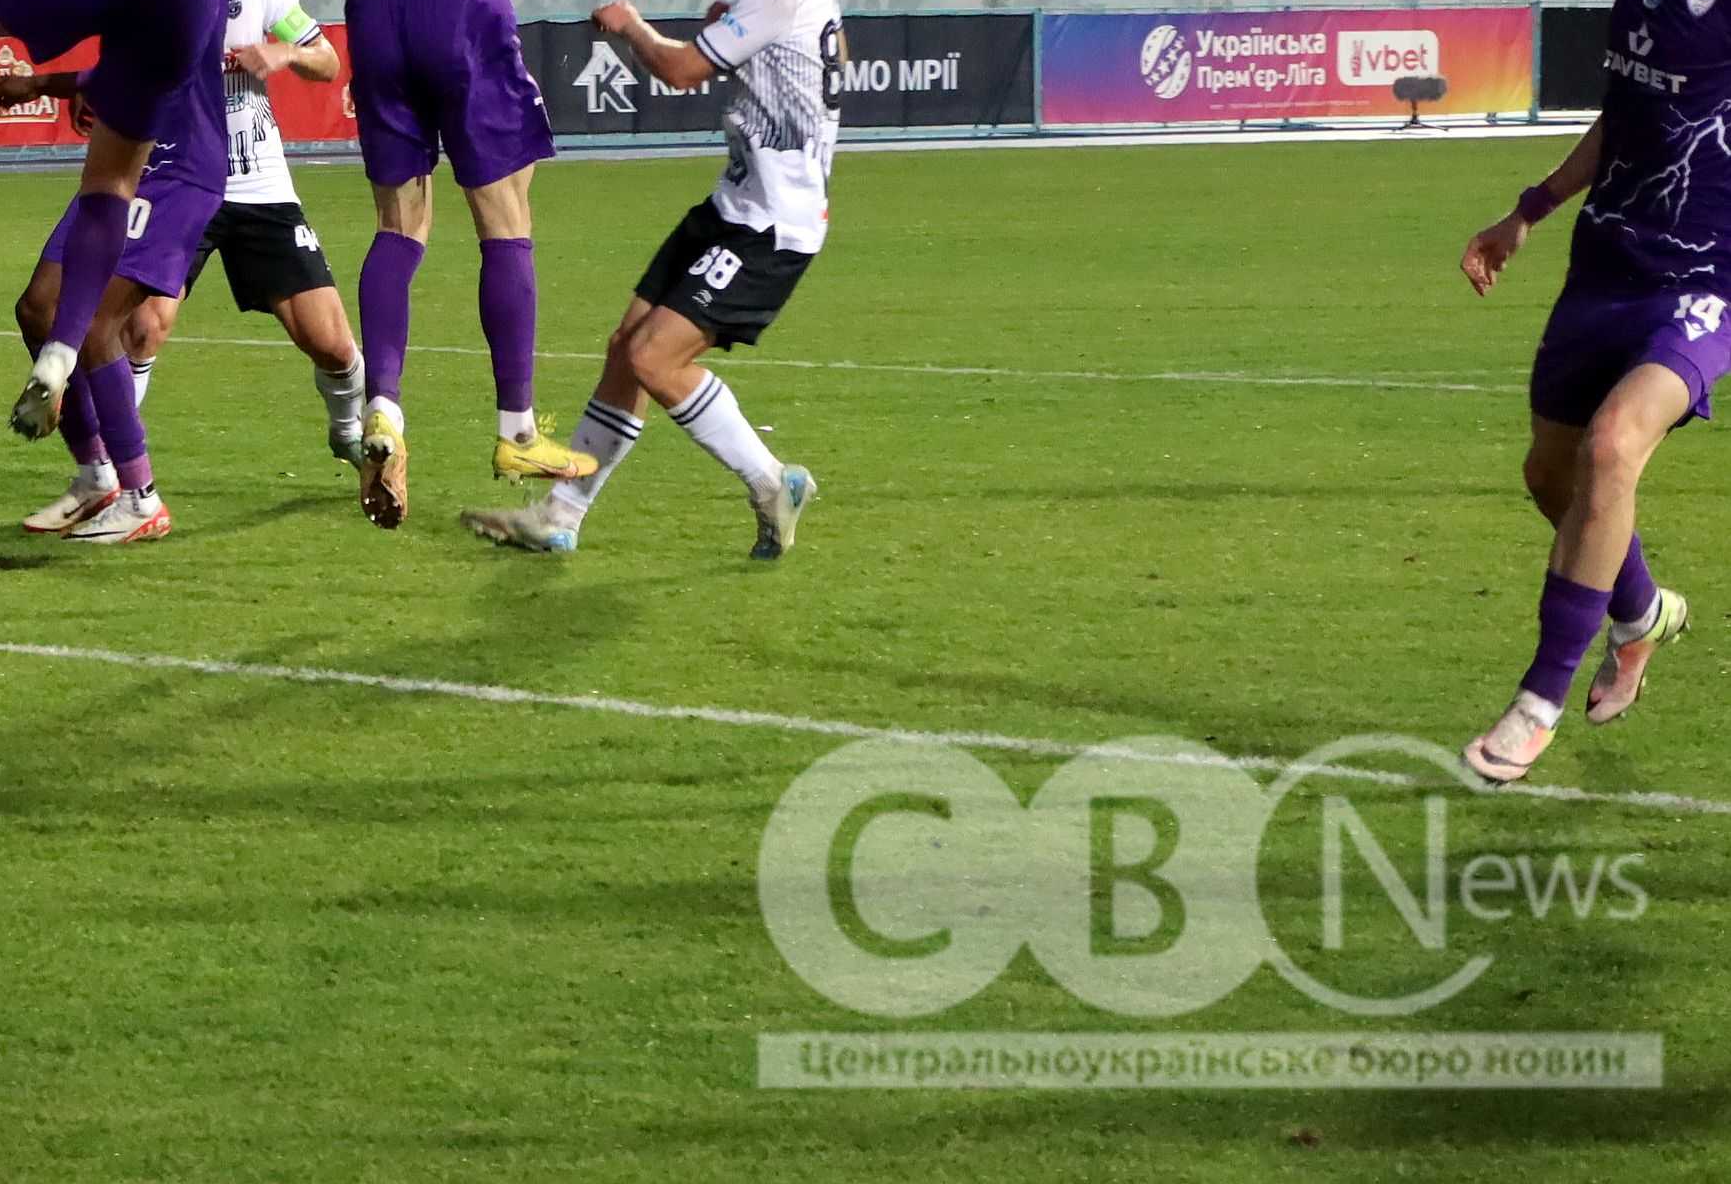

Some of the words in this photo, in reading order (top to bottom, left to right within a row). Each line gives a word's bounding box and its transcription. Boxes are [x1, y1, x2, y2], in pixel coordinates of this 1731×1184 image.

[1195, 27, 1328, 62] Українська
[1365, 43, 1429, 72] vbet
[899, 53, 961, 92] МРІЇ
[1196, 63, 1327, 93] Прем'єр-Ліга
[1673, 293, 1728, 342] 14
